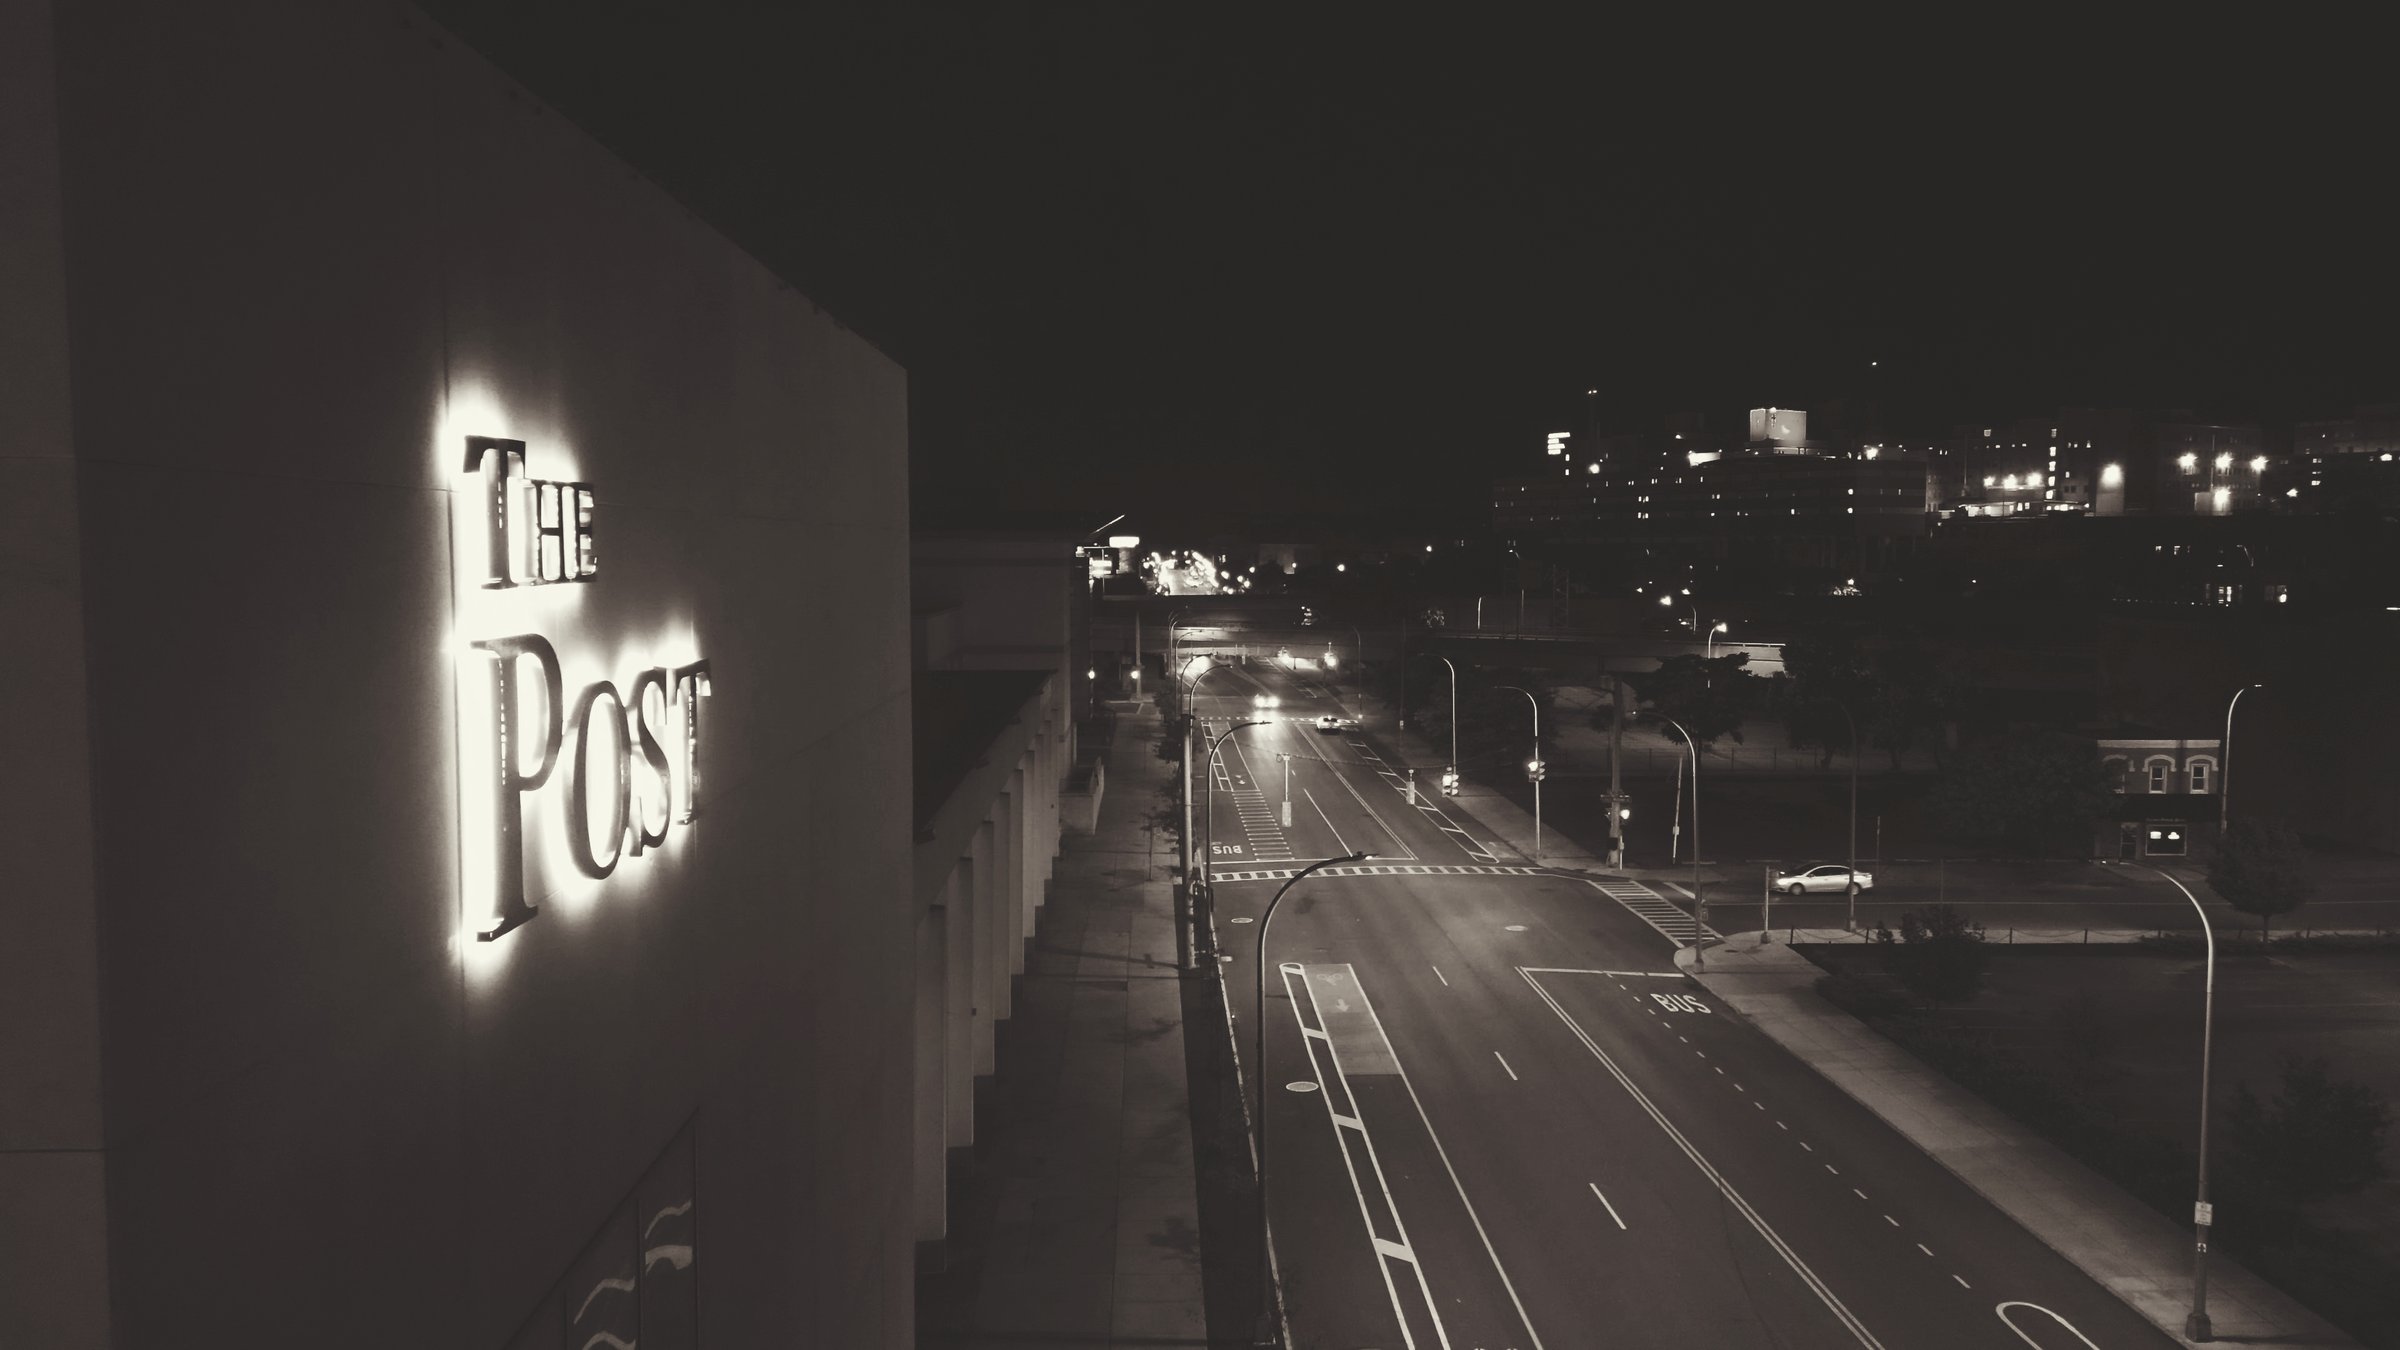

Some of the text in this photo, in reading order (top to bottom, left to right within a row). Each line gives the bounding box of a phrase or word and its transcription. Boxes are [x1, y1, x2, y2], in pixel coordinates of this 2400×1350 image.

[463, 435, 598, 590] THE
[470, 633, 712, 942] POST
[1212, 845, 1243, 855] BUS
[1650, 993, 1712, 1014] BUS
